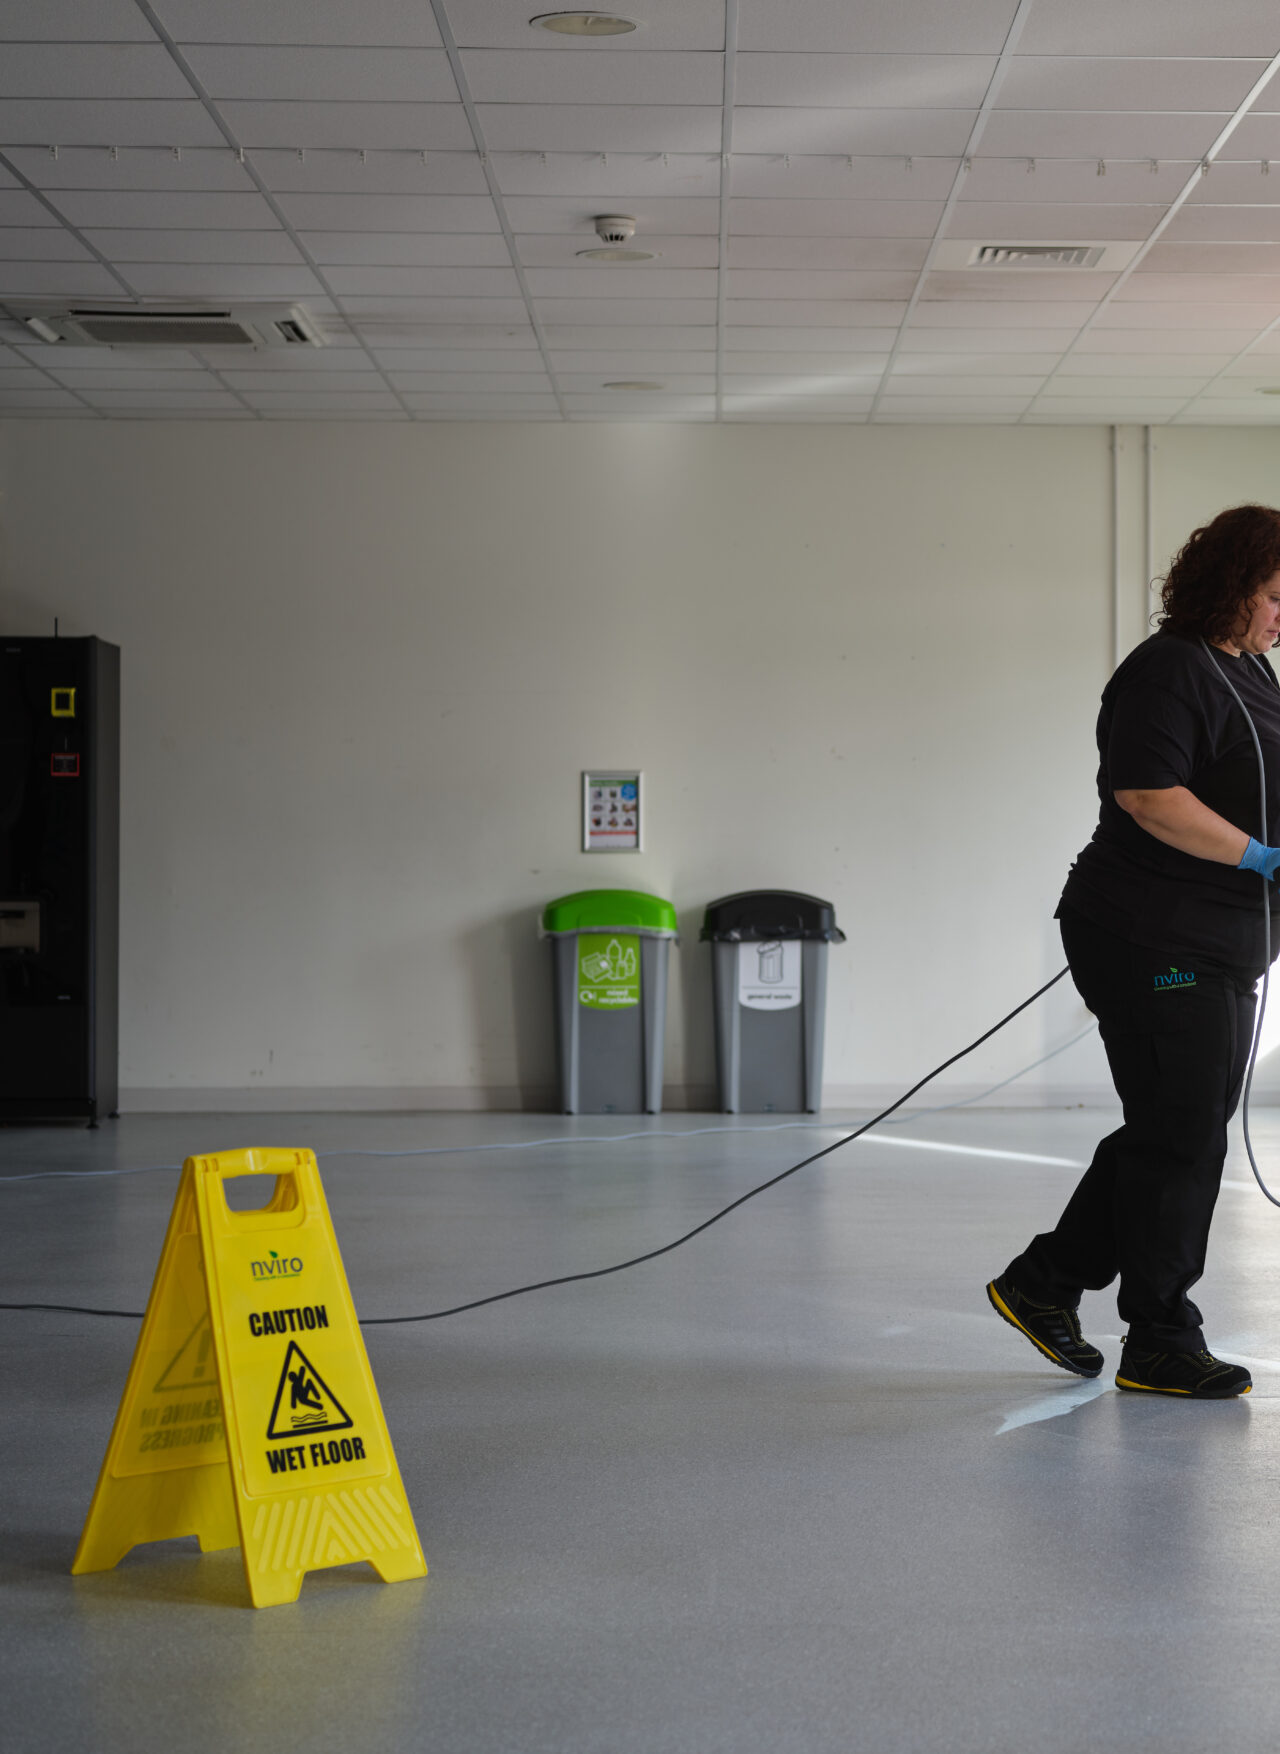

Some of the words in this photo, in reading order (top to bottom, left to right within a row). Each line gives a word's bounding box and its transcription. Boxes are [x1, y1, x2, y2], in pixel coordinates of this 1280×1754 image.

[1154, 967, 1195, 987] nviro
[250, 1250, 303, 1277] nviro
[248, 1305, 329, 1338] CAUTION
[265, 1445, 306, 1474] WET
[309, 1437, 366, 1468] FLOOR
